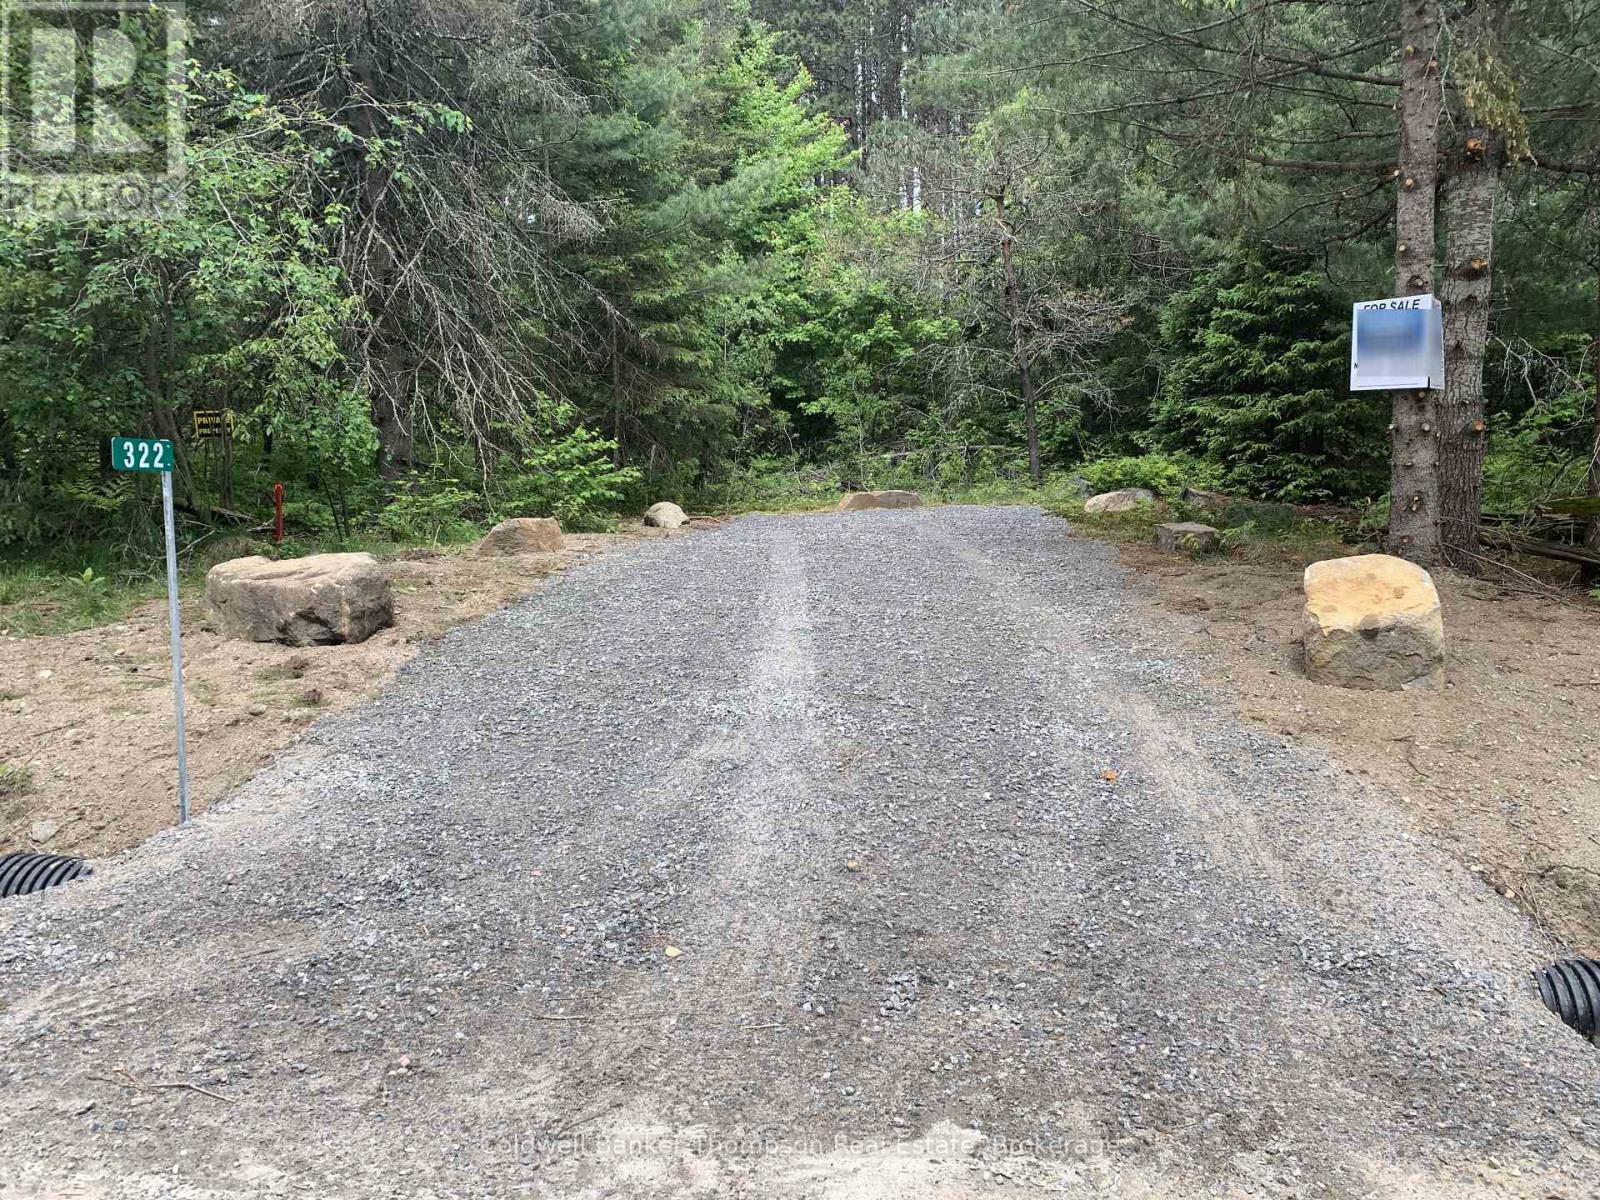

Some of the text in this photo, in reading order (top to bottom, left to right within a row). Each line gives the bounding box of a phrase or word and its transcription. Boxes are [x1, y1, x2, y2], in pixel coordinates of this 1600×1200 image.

[1390, 299, 1420, 310] SALE
[197, 415, 231, 424] PRIVAE
[123, 441, 164, 468] 322
